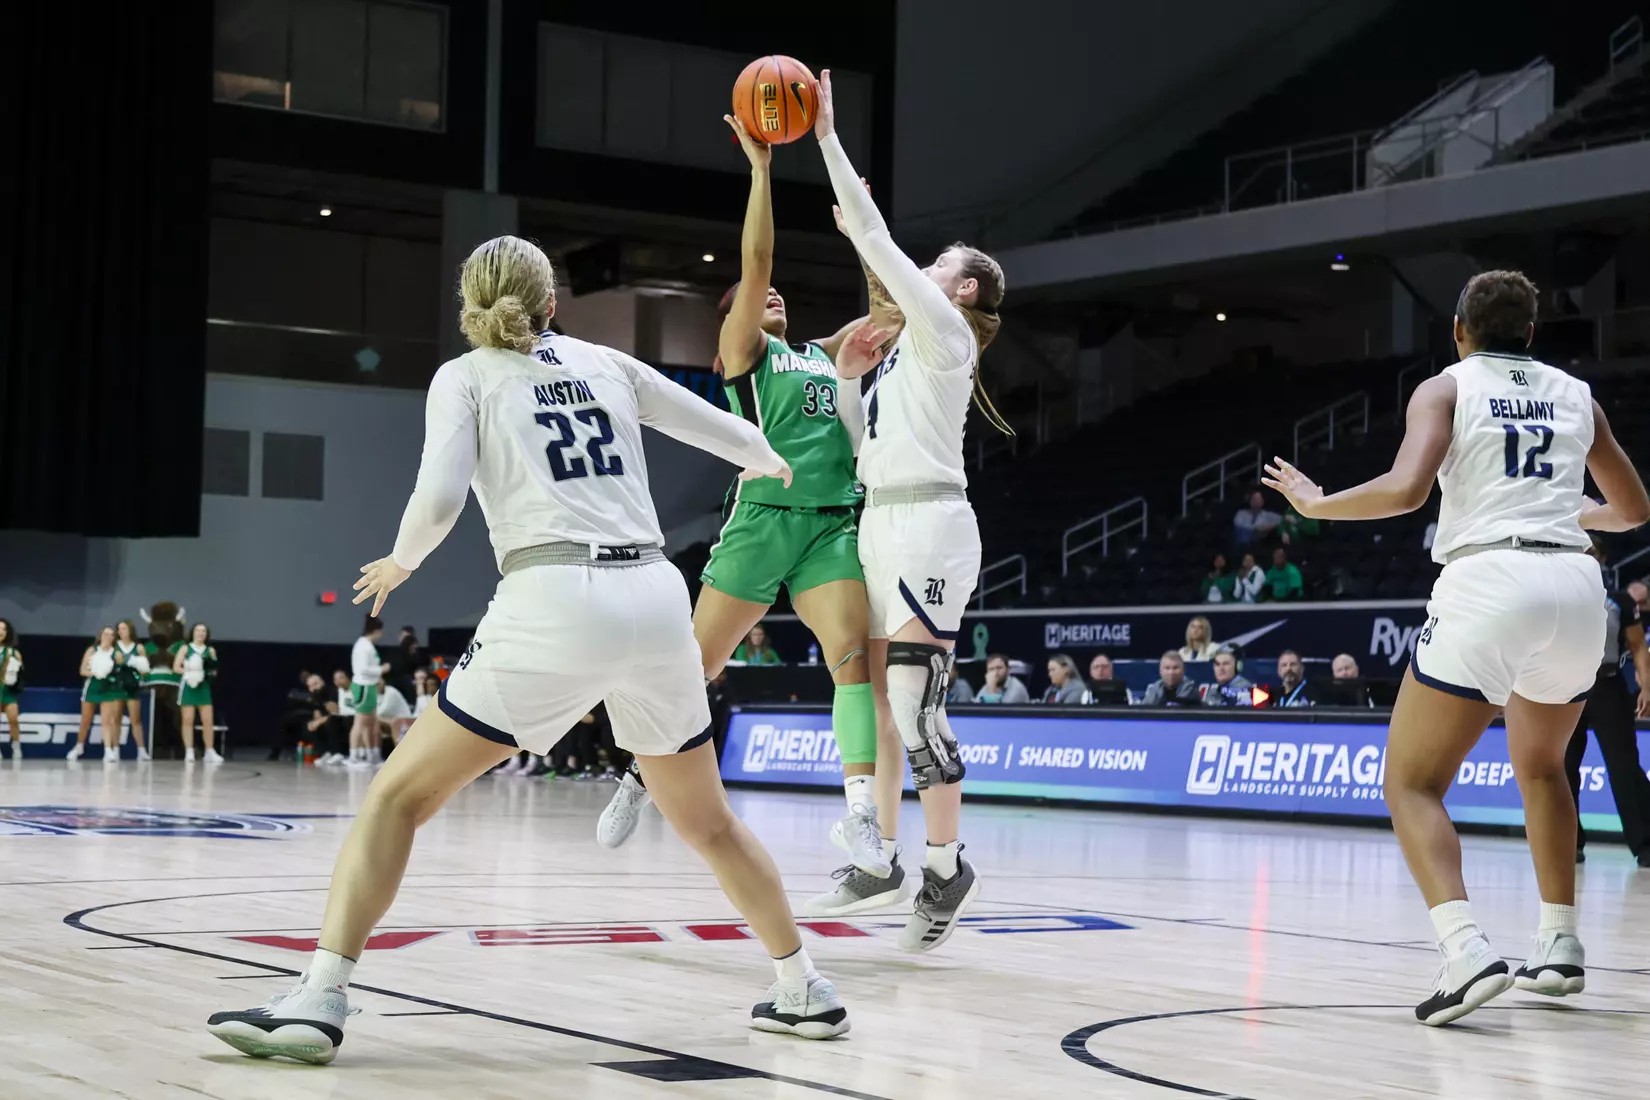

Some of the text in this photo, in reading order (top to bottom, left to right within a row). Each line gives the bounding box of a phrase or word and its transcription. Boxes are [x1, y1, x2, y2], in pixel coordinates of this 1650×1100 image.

[762, 83, 780, 131] ELITE
[533, 380, 596, 406] AUSTIN
[801, 380, 838, 418] 33
[1489, 398, 1554, 420] BELLAMY
[534, 407, 624, 482] 22
[1502, 424, 1554, 479] 12
[1061, 624, 1130, 641] HERITAGE
[957, 744, 999, 766] OOTS
[1018, 746, 1084, 769] SHARED
[1088, 749, 1148, 772] VISION
[1457, 762, 1515, 786] DEEP
[1224, 781, 1296, 796] LANDSCAPE
[1299, 785, 1348, 799] SUPPLY
